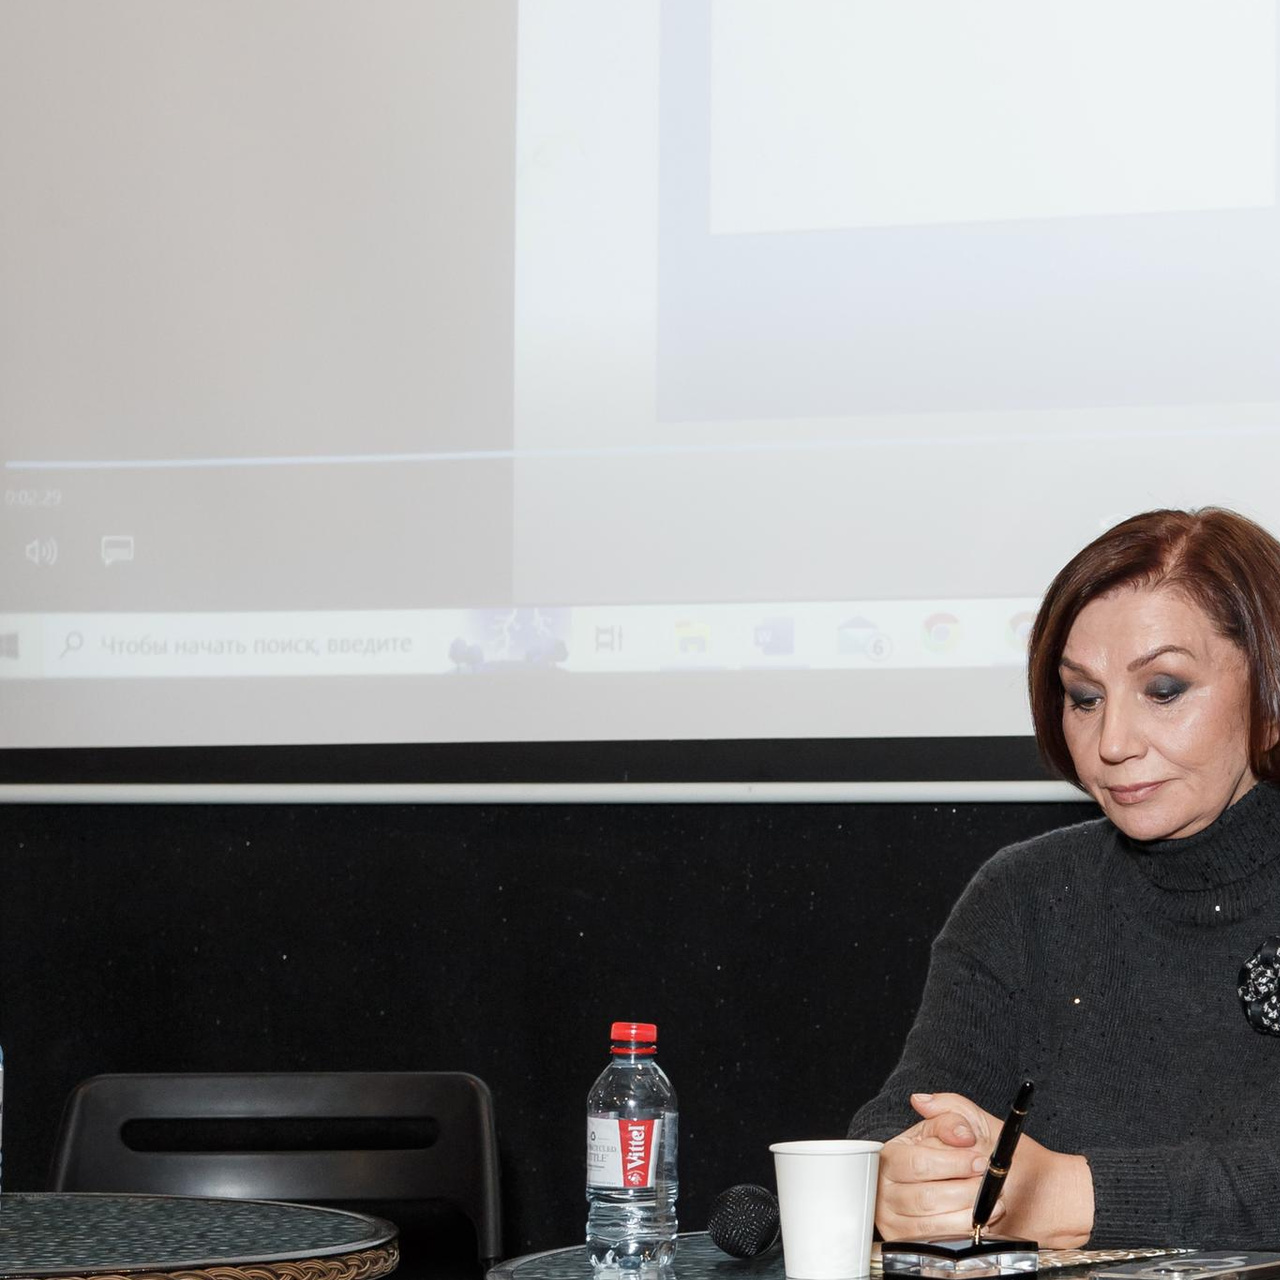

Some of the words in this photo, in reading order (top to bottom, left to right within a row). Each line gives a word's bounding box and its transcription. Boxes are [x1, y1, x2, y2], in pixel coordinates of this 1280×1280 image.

[100, 634, 168, 656] Чтобы
[174, 635, 246, 656] начать
[253, 633, 320, 656] поиск,
[326, 632, 413, 655] введите
[625, 1123, 646, 1170] Vittel
